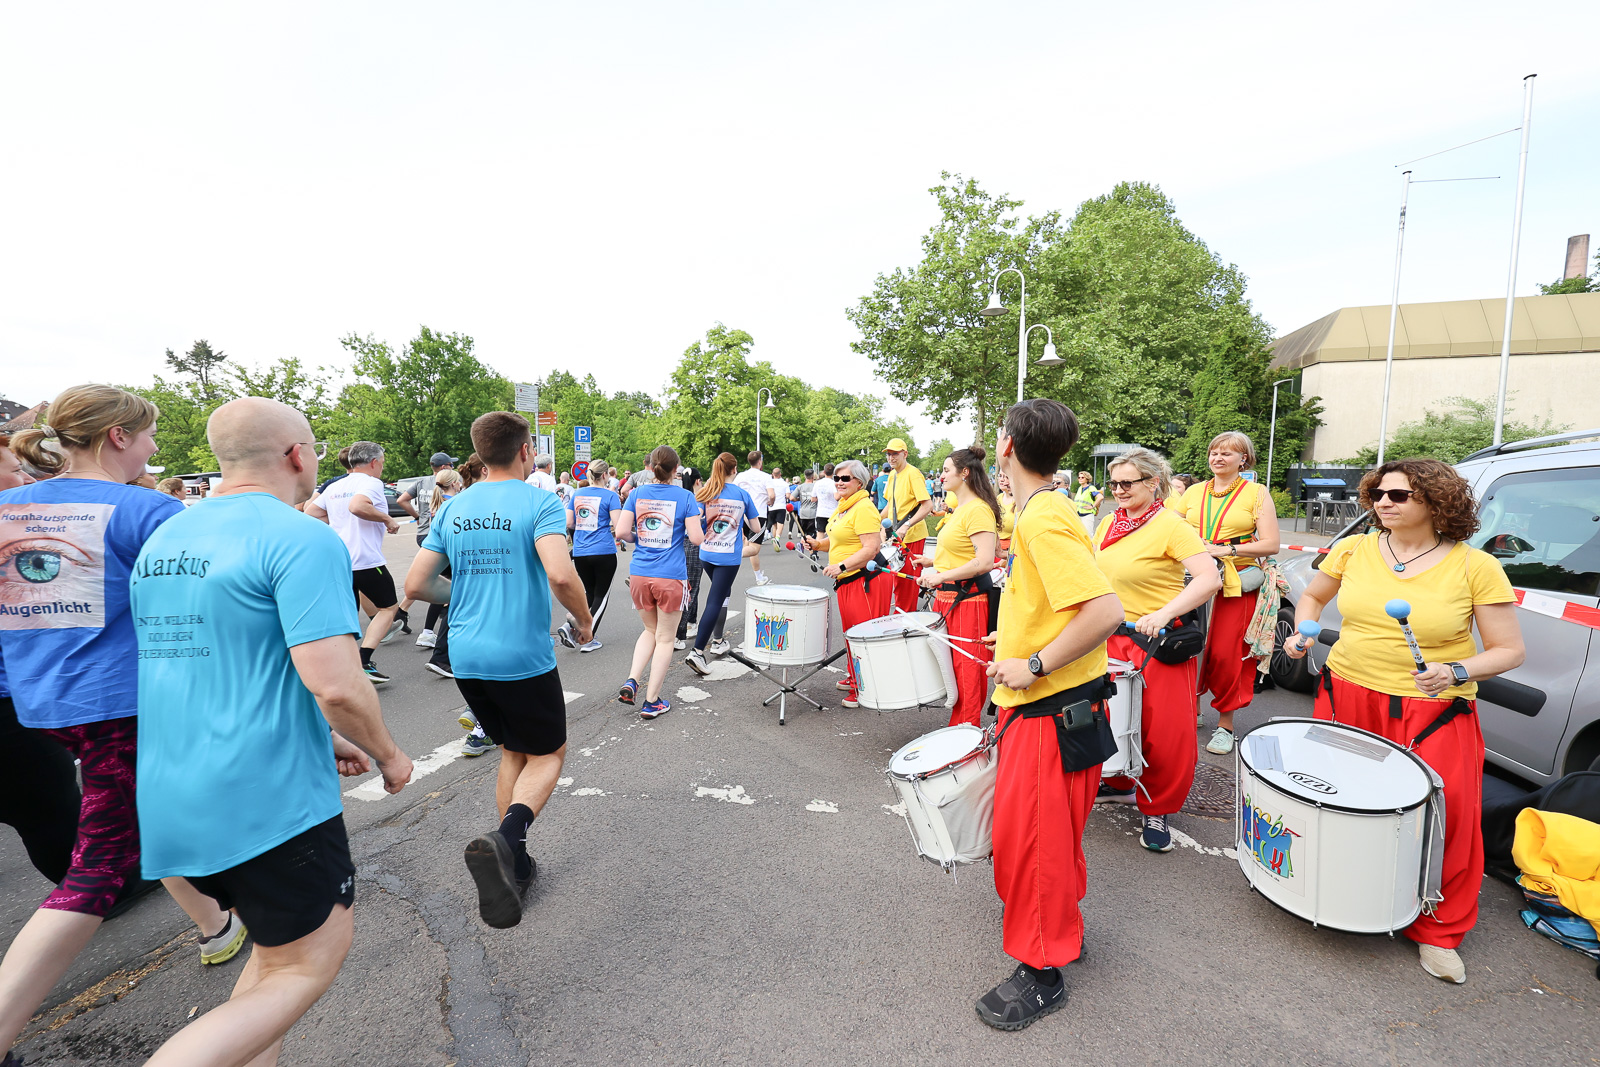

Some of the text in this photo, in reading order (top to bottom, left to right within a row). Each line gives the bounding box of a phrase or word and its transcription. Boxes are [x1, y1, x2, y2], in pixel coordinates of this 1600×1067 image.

[578, 428, 587, 441] P
[2, 513, 95, 523] Hornhautspende
[453, 512, 512, 534] Sascha
[25, 525, 66, 533] schenkt
[0, 602, 92, 617] Augenlicht
